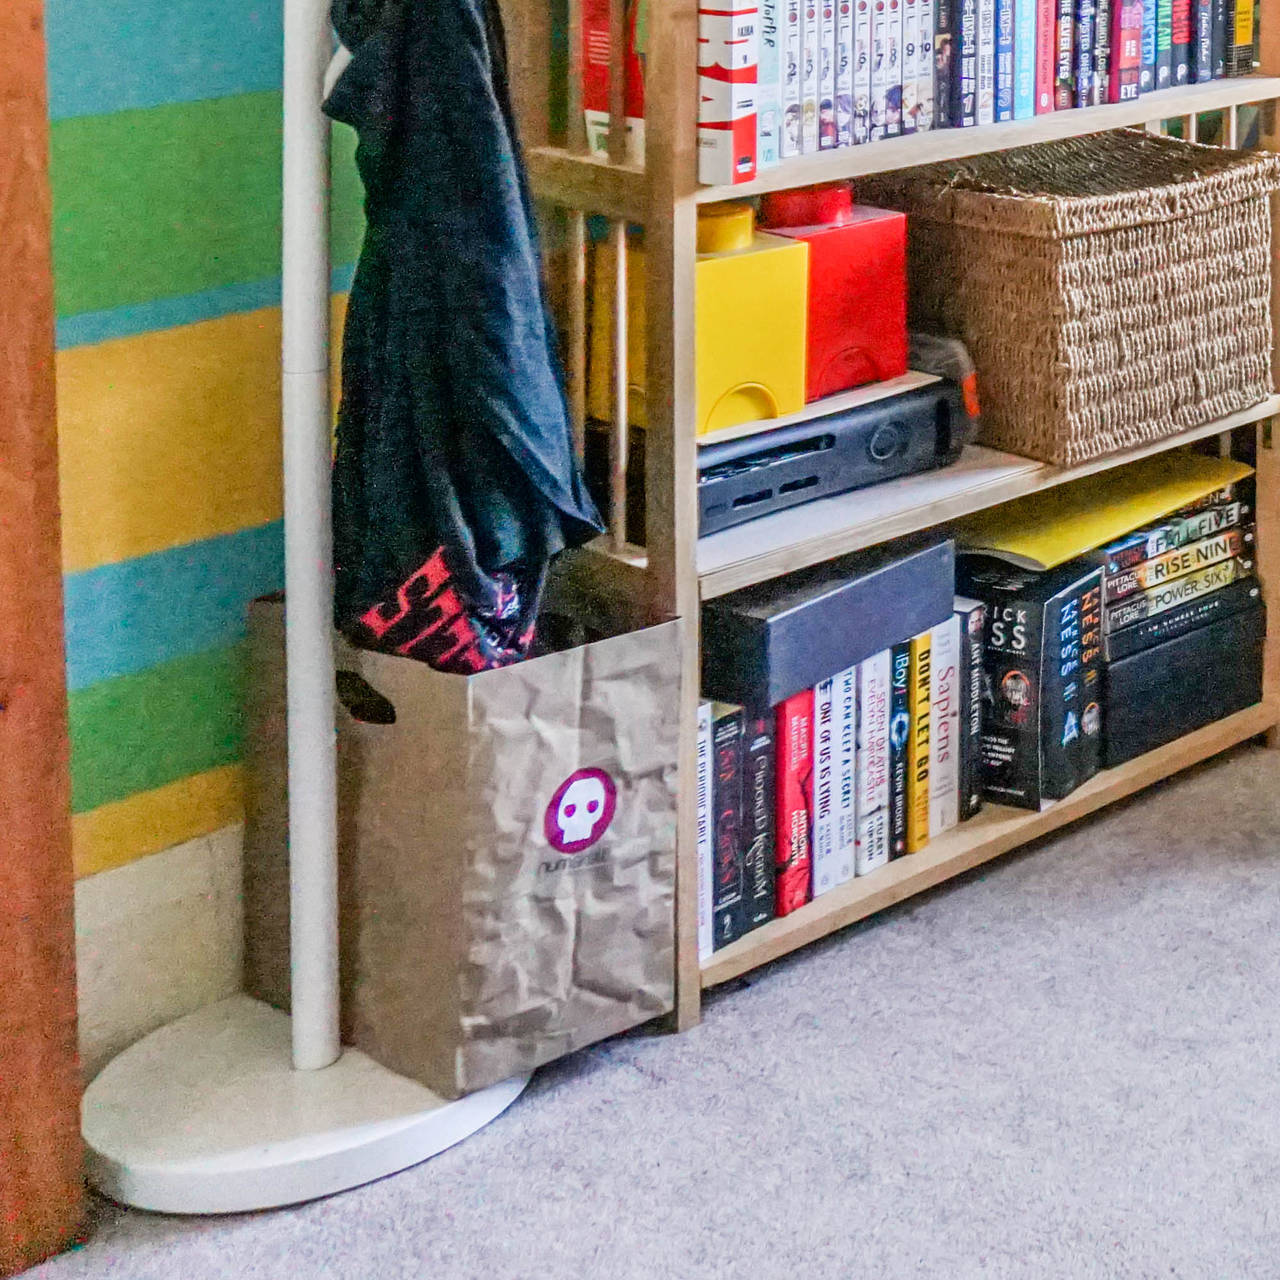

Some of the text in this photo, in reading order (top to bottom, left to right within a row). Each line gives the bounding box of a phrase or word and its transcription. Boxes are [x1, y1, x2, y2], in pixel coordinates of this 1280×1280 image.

[1060, 15, 1072, 46] SILVER
[1080, 9, 1091, 50] TWISTED
[1059, 47, 1071, 79] EYES
[1120, 83, 1138, 100] EYE
[1198, 506, 1236, 536] FIVE
[1107, 570, 1140, 589] PITTACU
[1154, 552, 1191, 580] RISE
[1116, 579, 1139, 594] LORE
[1155, 571, 1224, 608] POWER SIX
[1110, 599, 1147, 619] PITTACUS
[1119, 610, 1140, 625] LORE
[990, 621, 1026, 650] SS
[1059, 602, 1073, 677] NESS
[1081, 591, 1094, 664] NESS
[842, 671, 853, 693] TWO
[969, 642, 979, 736] ANT MIDDLETON
[819, 701, 831, 724] ONE
[842, 696, 852, 720] CAN
[917, 648, 931, 783] DON'T LET GO
[932, 665, 958, 763] Sapiens
[697, 738, 707, 758] THE
[799, 715, 809, 758] MAGPIE
[819, 729, 831, 744] OF
[841, 724, 852, 753] KEEP
[866, 679, 876, 803] EVELYN HARDCASTLE
[875, 691, 886, 787] SEVEN DEATHS
[819, 746, 831, 763] US
[819, 769, 831, 778] IS
[841, 769, 852, 809] SECRET
[819, 781, 831, 819] LYING
[894, 762, 904, 835] KEVIN BROOKS
[745, 754, 770, 899] CROOKED KINGDOM
[790, 809, 800, 866] HOROWITZ
[797, 809, 808, 859] ANTHONY
[866, 819, 876, 861] TURTON
[875, 815, 885, 857] STUART
